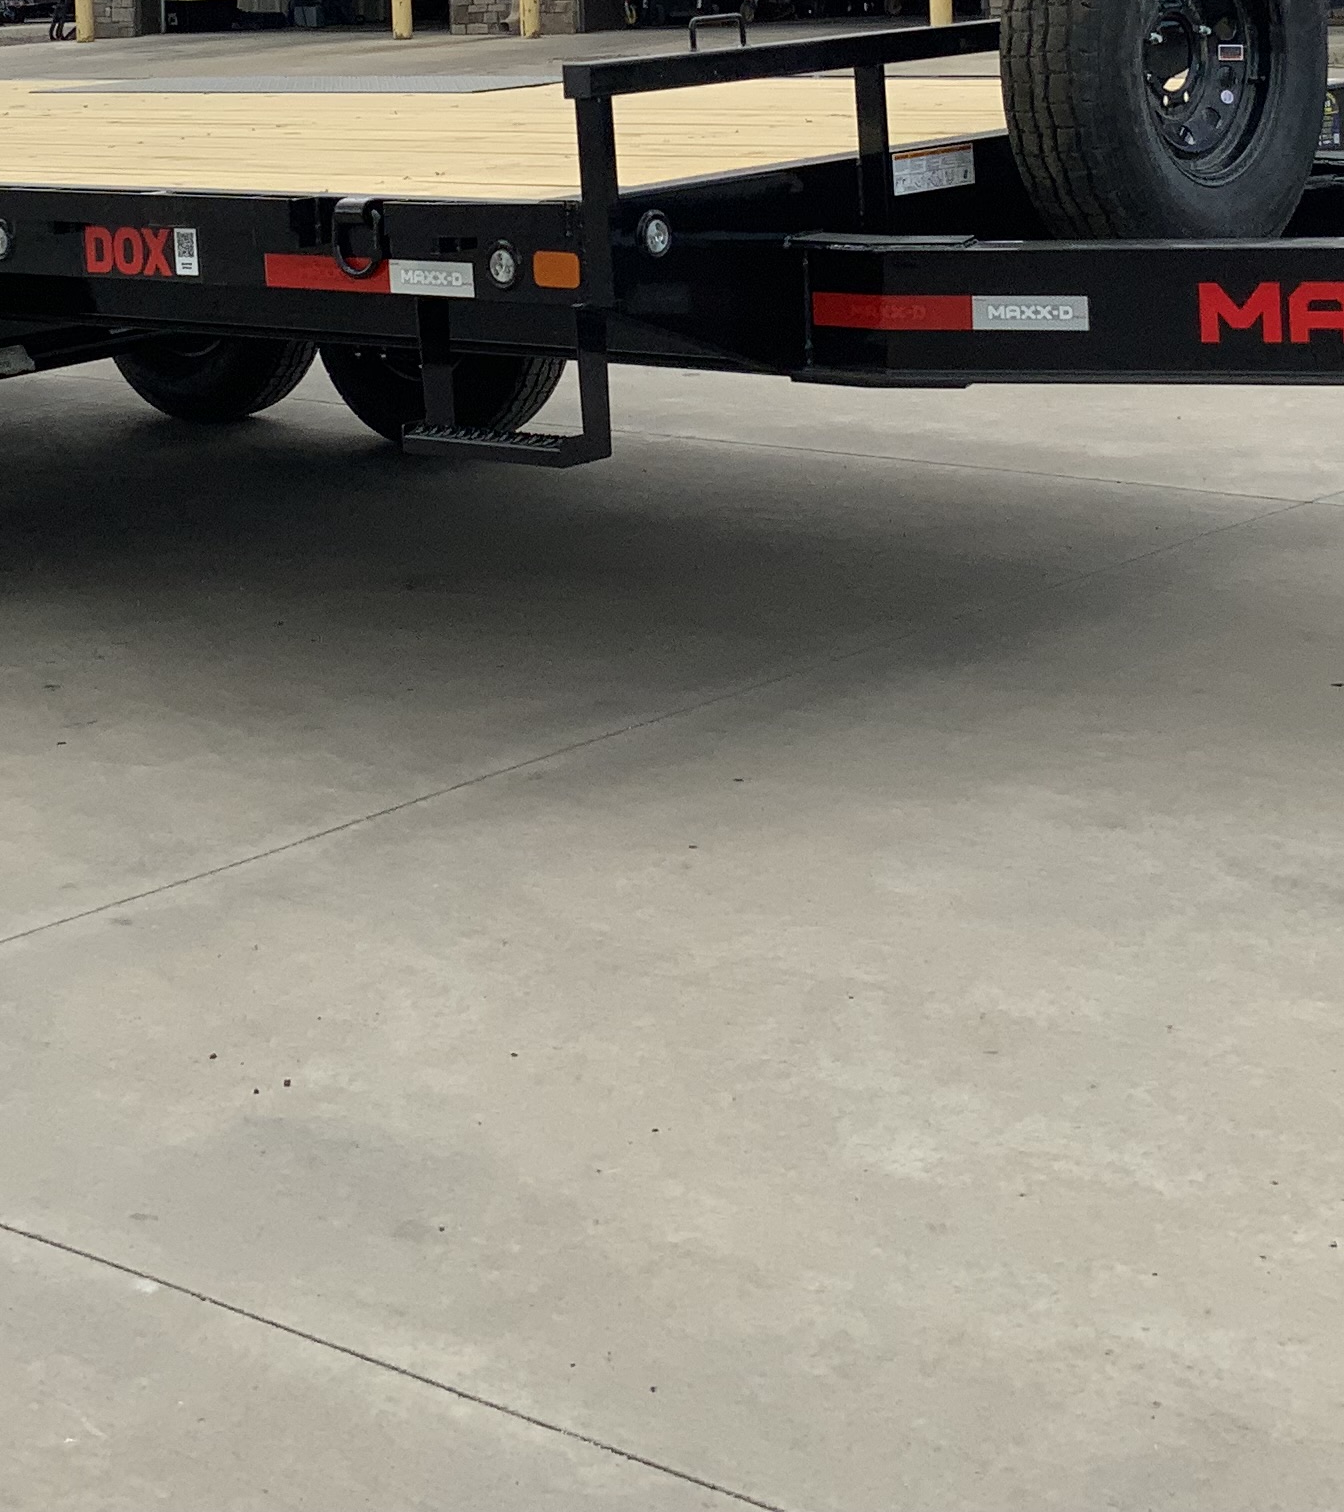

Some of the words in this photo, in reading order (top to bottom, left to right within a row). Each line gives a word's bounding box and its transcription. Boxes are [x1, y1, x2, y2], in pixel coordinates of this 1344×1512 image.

[84, 226, 174, 277] DOX
[400, 269, 463, 286] MAXX-D
[987, 305, 1074, 320] MAXX-D
